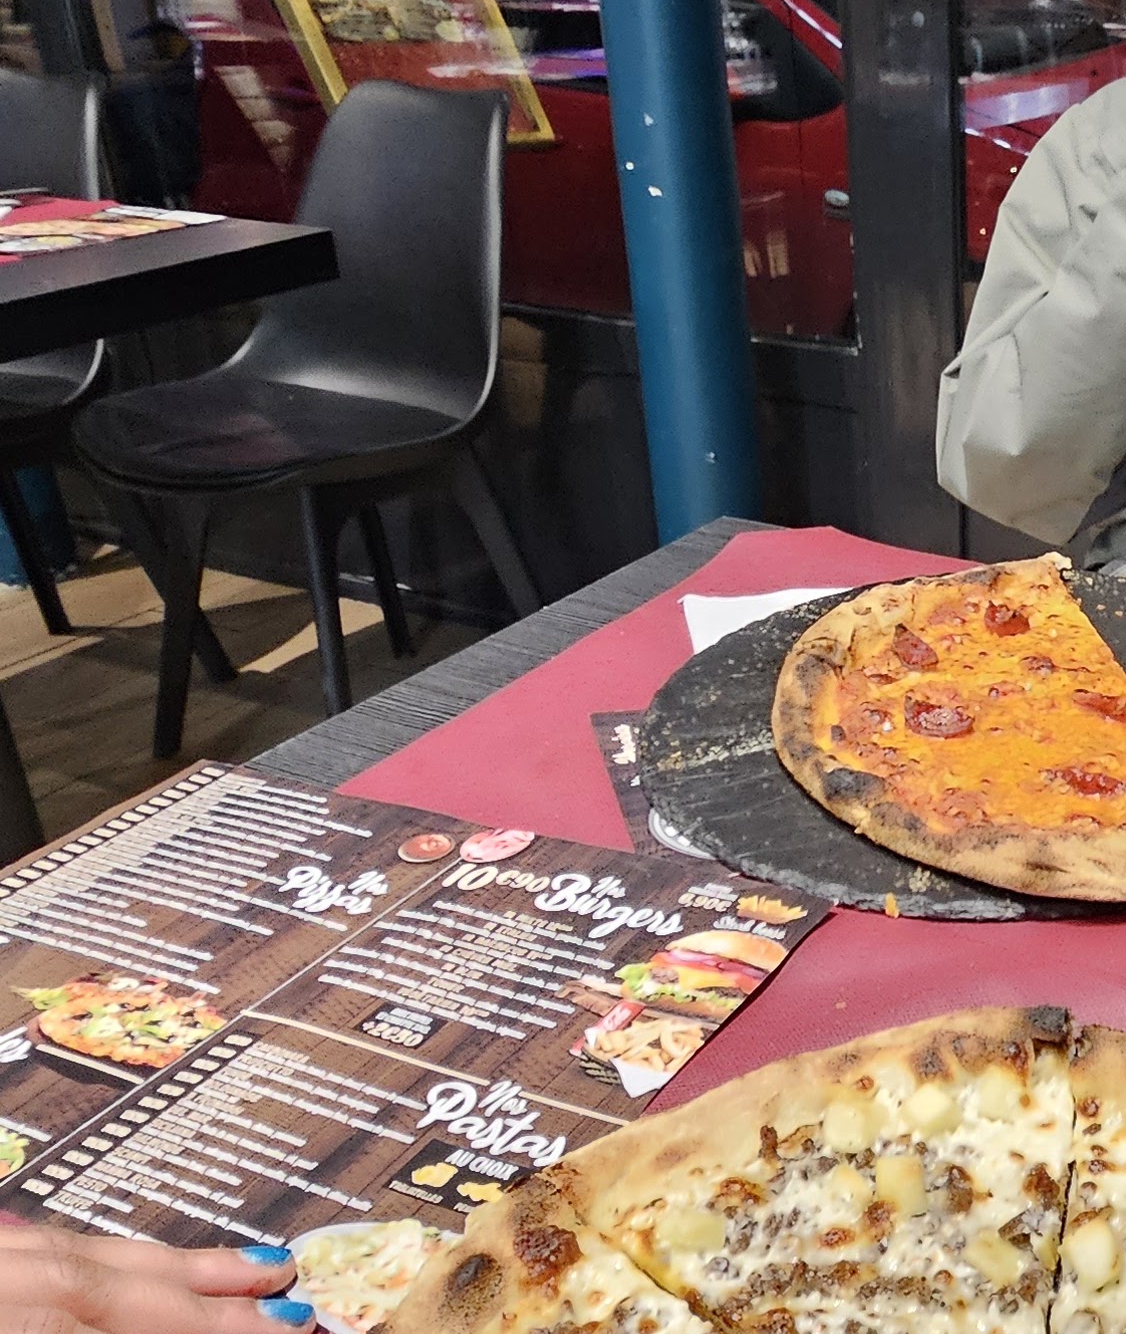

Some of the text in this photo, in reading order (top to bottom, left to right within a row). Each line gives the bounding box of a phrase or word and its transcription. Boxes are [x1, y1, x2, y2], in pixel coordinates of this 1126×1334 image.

[278, 866, 373, 915] Pizzas
[534, 873, 684, 939] Burgers
[478, 1080, 528, 1117] Nos
[416, 1081, 567, 1167] Pastas
[444, 1149, 520, 1181] AU CHOIX
